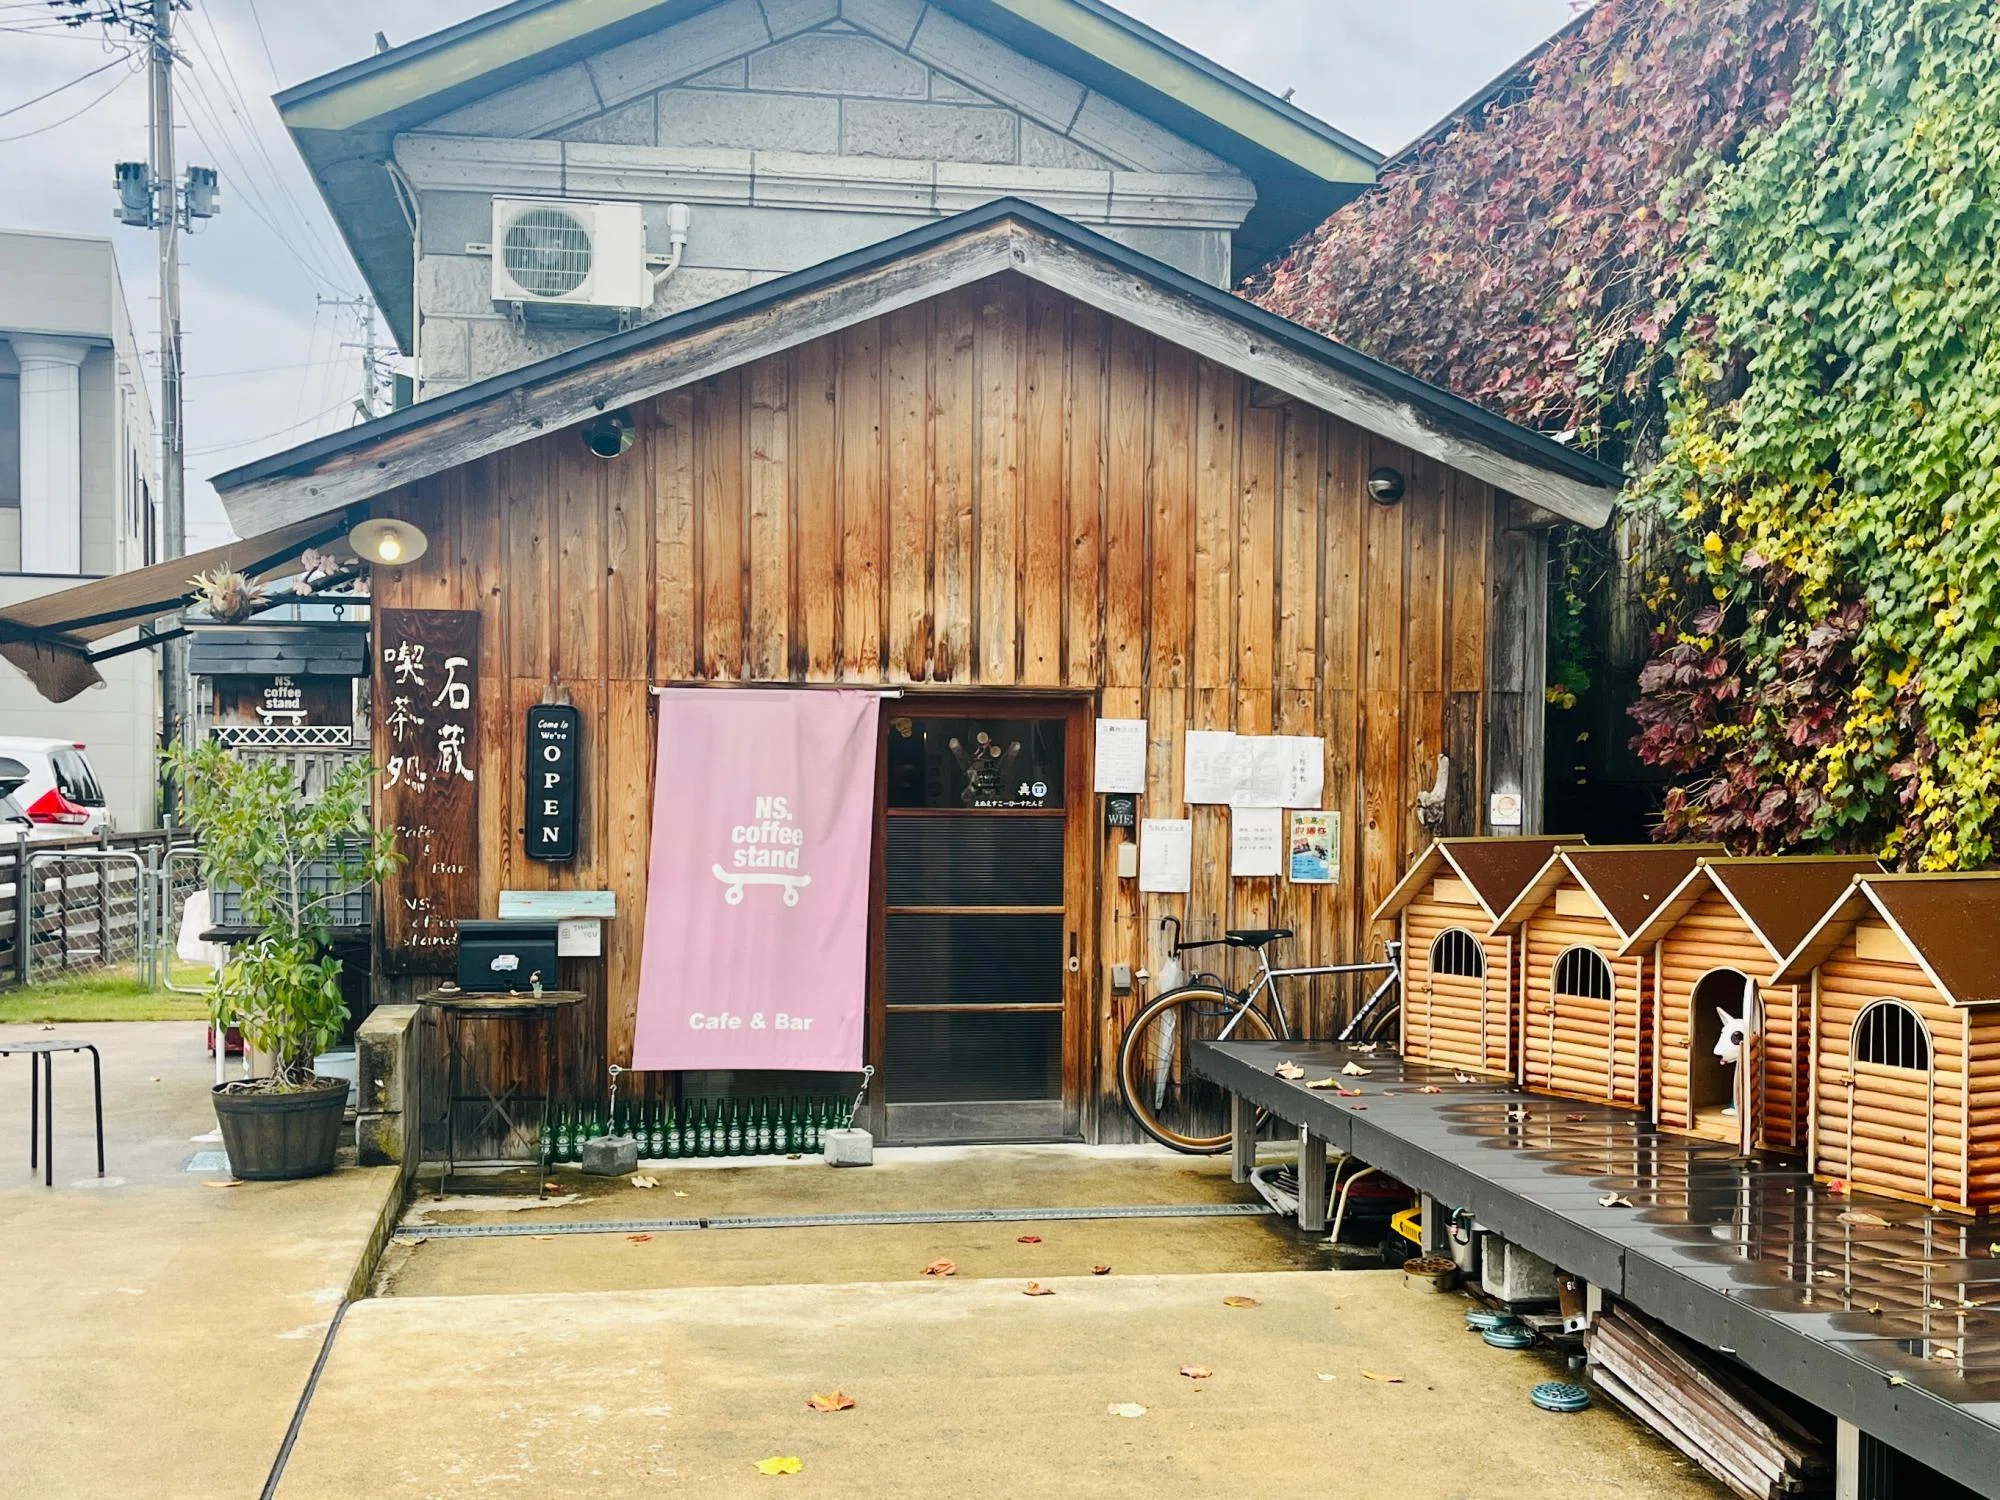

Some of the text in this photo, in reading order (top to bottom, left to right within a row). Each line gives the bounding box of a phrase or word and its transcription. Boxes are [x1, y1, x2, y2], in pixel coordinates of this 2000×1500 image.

[274, 676, 294, 687] NS.
[264, 686, 301, 698] coffee
[265, 698, 299, 709] stand
[538, 719, 559, 729] Come
[540, 731, 567, 740] We're
[542, 745, 561, 842] OPEN
[755, 796, 793, 820] NS.
[732, 820, 803, 846] coffee
[733, 845, 799, 869] stand
[689, 1012, 814, 1031] Cafe & Bar
